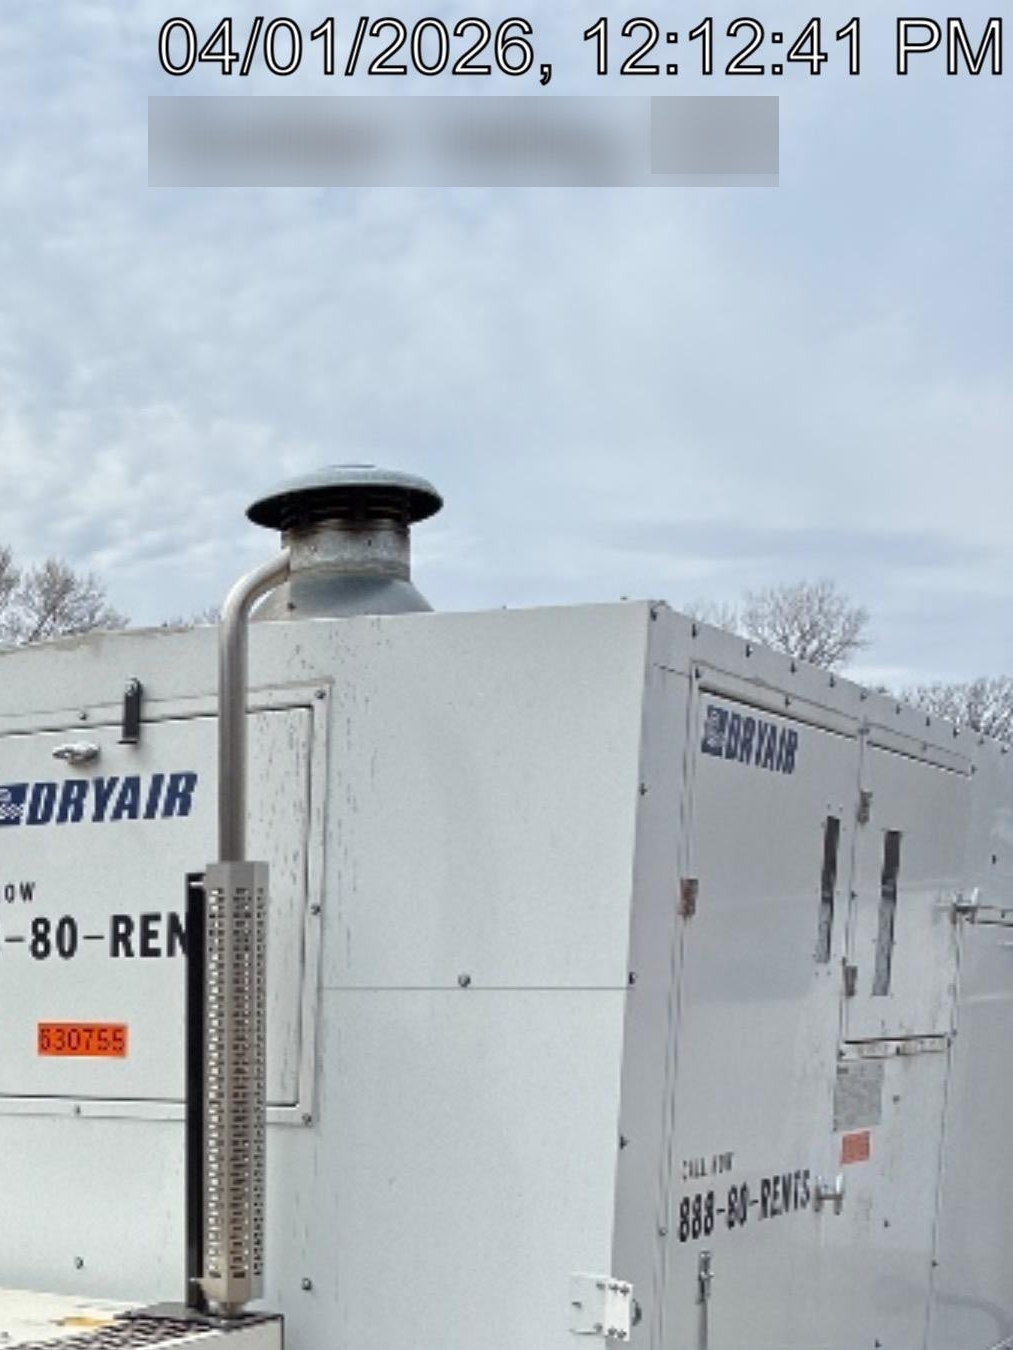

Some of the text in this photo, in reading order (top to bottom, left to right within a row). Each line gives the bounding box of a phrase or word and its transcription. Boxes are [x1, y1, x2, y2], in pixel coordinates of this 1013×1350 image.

[725, 710, 798, 775] DRYAIR
[26, 771, 198, 825] DRYAIR
[678, 1169, 811, 1243] 888-80-RENTS
